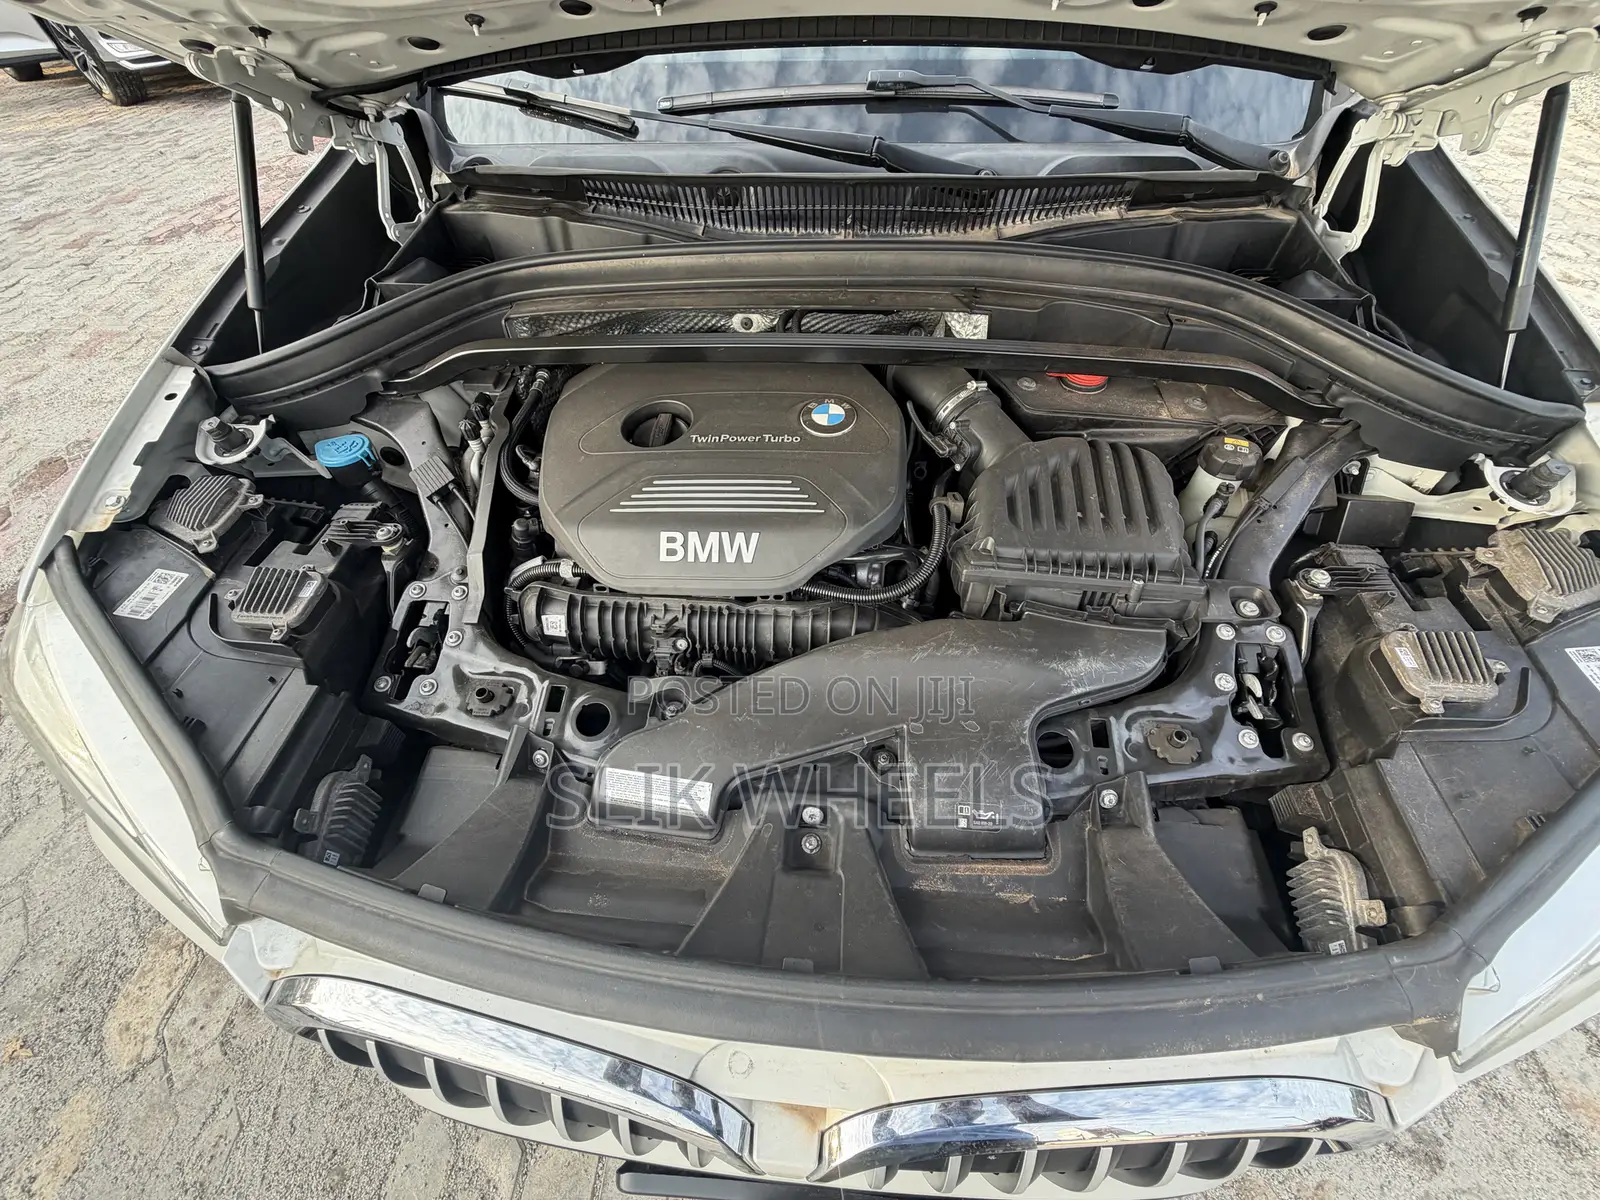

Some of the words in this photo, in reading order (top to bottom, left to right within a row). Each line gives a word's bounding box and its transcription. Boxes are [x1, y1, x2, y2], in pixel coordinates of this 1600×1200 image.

[690, 434, 762, 444] TwinPower
[762, 434, 801, 443] Turbo
[659, 531, 760, 563] BMW
